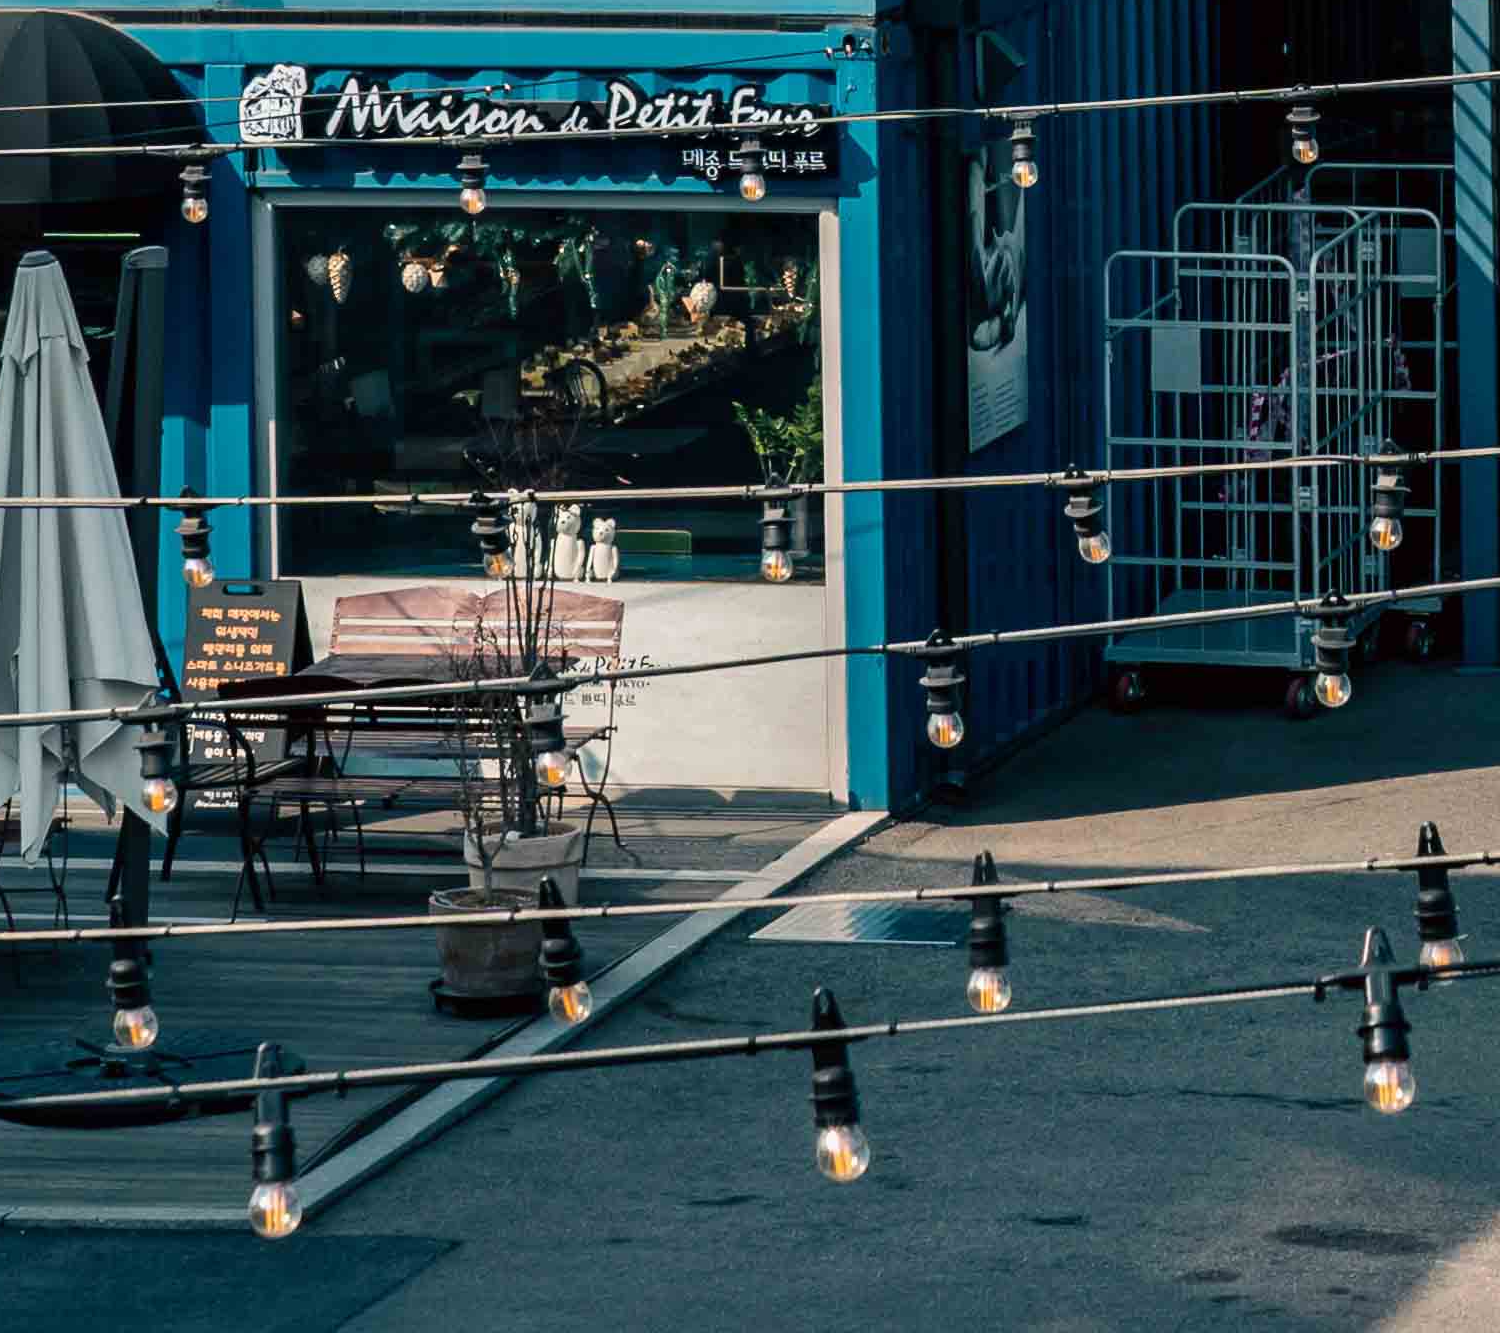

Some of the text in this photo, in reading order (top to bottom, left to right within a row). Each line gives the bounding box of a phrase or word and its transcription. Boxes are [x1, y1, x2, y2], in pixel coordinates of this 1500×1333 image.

[326, 77, 822, 140] Maison de Petit Four
